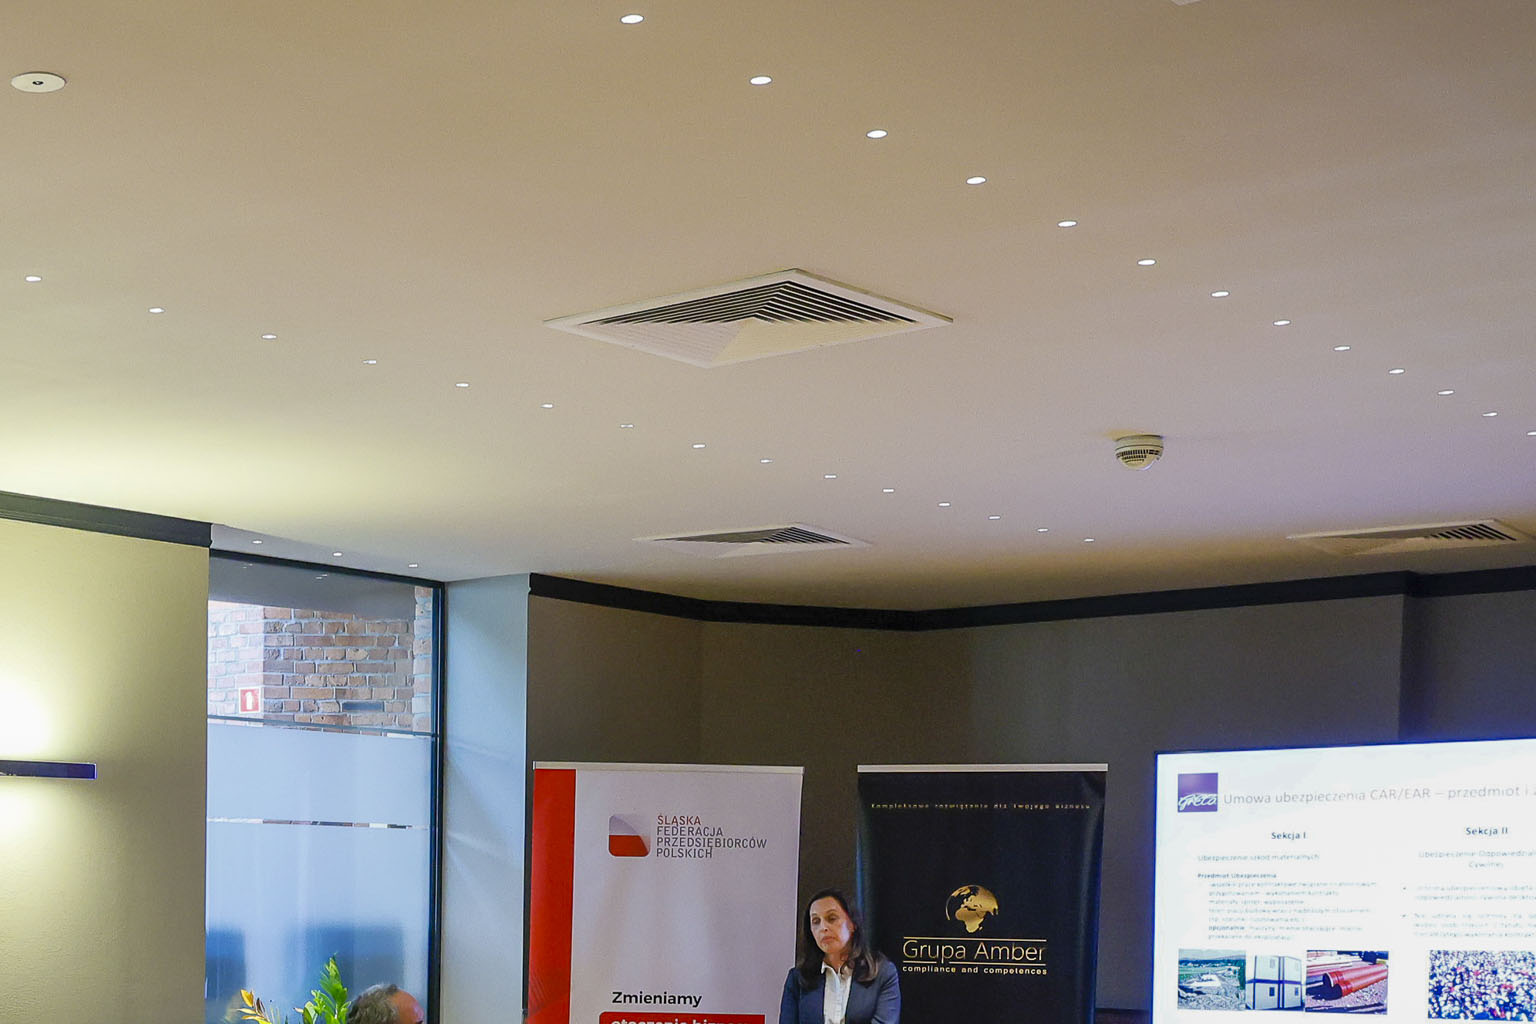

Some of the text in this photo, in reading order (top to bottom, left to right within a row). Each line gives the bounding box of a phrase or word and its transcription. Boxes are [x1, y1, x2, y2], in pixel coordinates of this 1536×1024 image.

[1223, 792, 1271, 805] Umowa
[1275, 790, 1365, 805] ubezpieczenia
[1370, 787, 1431, 801] CAR/EAR
[1448, 785, 1520, 800] przedmiot
[657, 813, 701, 826] ŚLĄSKA
[657, 826, 723, 837] FEDERACJA
[1271, 832, 1301, 841] Sekcja
[1466, 827, 1498, 837] Sekcja
[657, 836, 768, 850] PRZEDSIĘBIORCÓW
[656, 847, 713, 859] POLSKICH
[902, 939, 1046, 964] Grupa Amber
[902, 965, 956, 974] compliance
[983, 966, 1048, 975] competences
[612, 991, 703, 1007] Zmieniamy
